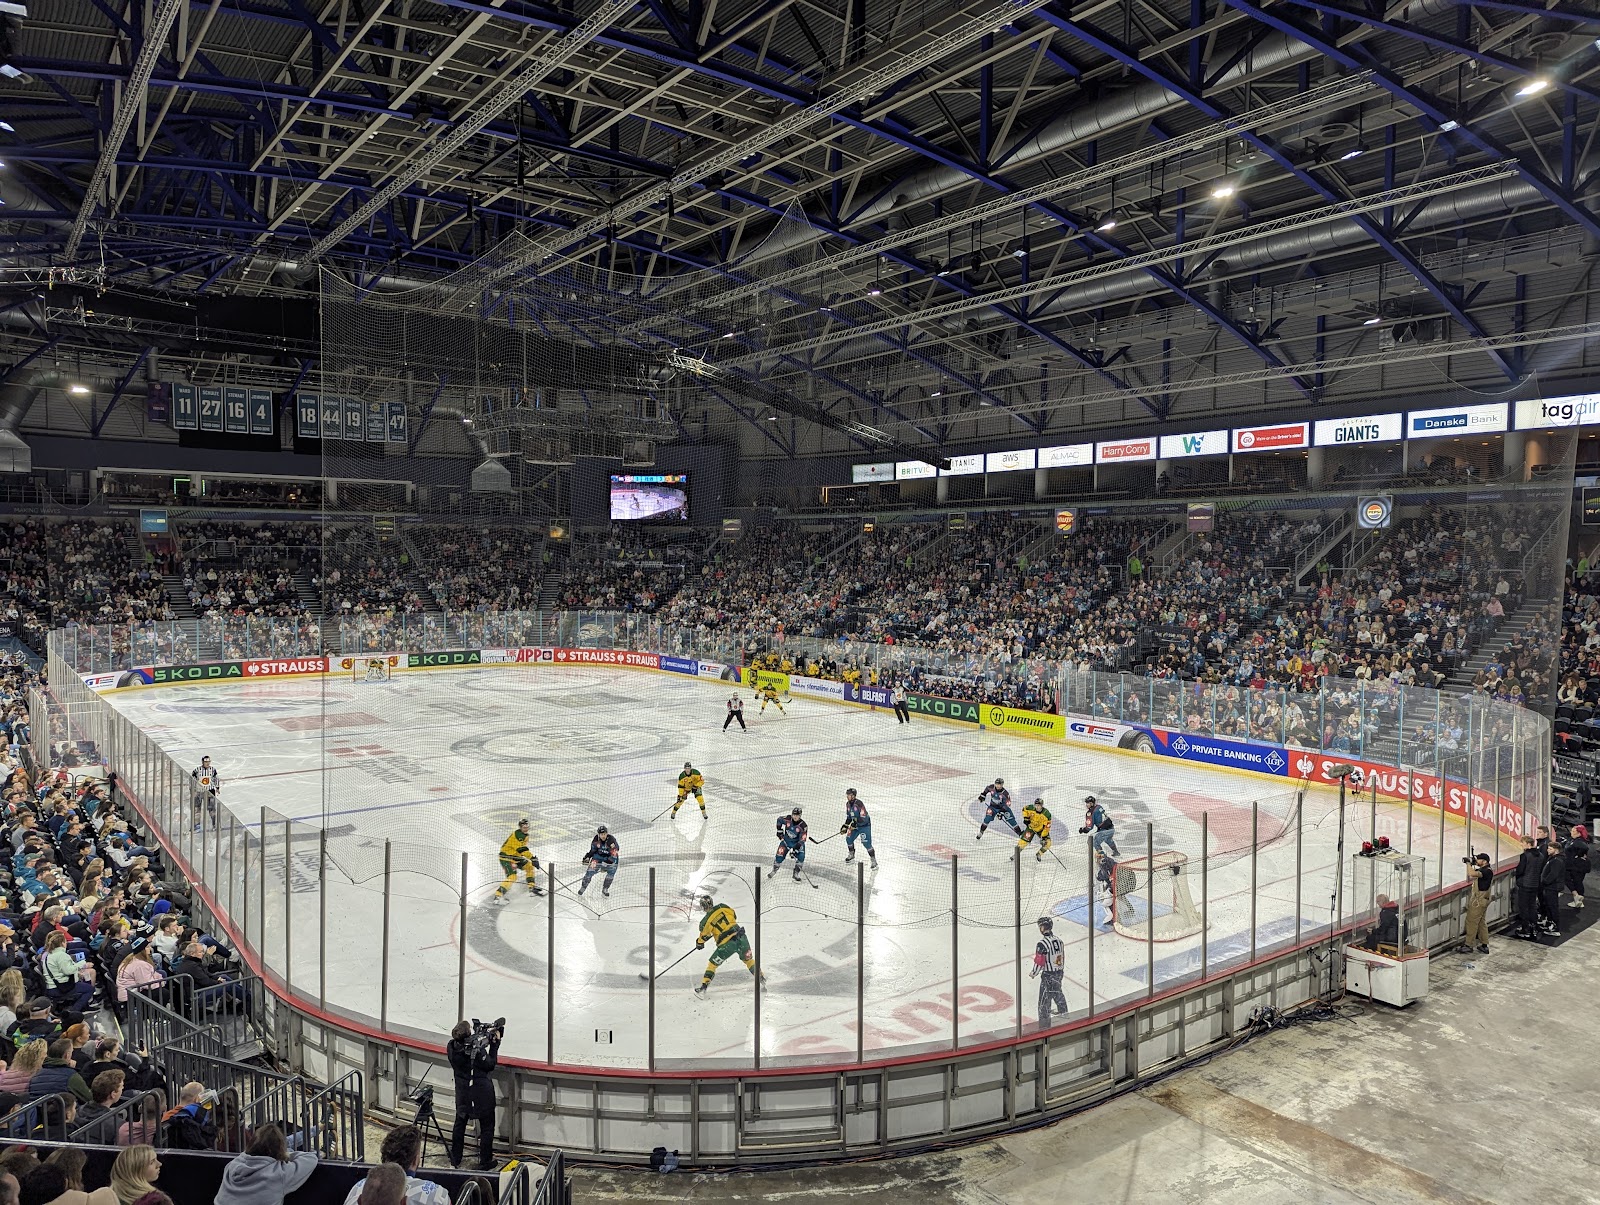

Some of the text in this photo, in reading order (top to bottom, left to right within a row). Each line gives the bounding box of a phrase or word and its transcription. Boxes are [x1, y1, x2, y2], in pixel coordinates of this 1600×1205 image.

[179, 398, 191, 414] 11
[202, 400, 220, 416] 27
[228, 402, 244, 418] 16
[256, 404, 266, 419] 4
[301, 408, 316, 423] 18
[323, 410, 339, 424] 44
[347, 412, 360, 426] 19
[390, 415, 404, 429] 47
[1426, 414, 1498, 428] Danske Bank
[1335, 425, 1379, 442] GIANTS
[1050, 452, 1079, 460] ALMAC
[1104, 445, 1148, 456] Harry Corry
[952, 458, 974, 467] ITANIC
[1002, 454, 1018, 462] aws
[902, 466, 930, 475] BRITVIC
[516, 649, 542, 662] APP
[569, 651, 616, 663] STRAUSS
[626, 653, 658, 666] STRAUSS
[261, 660, 324, 674] STRAUSS
[862, 690, 886, 703] BELFAST
[1006, 715, 1054, 730] WARRIOR
[1191, 745, 1262, 763] PRIVATE BANKING
[1449, 789, 1522, 840] STRAUSS
[710, 912, 730, 933] 17
